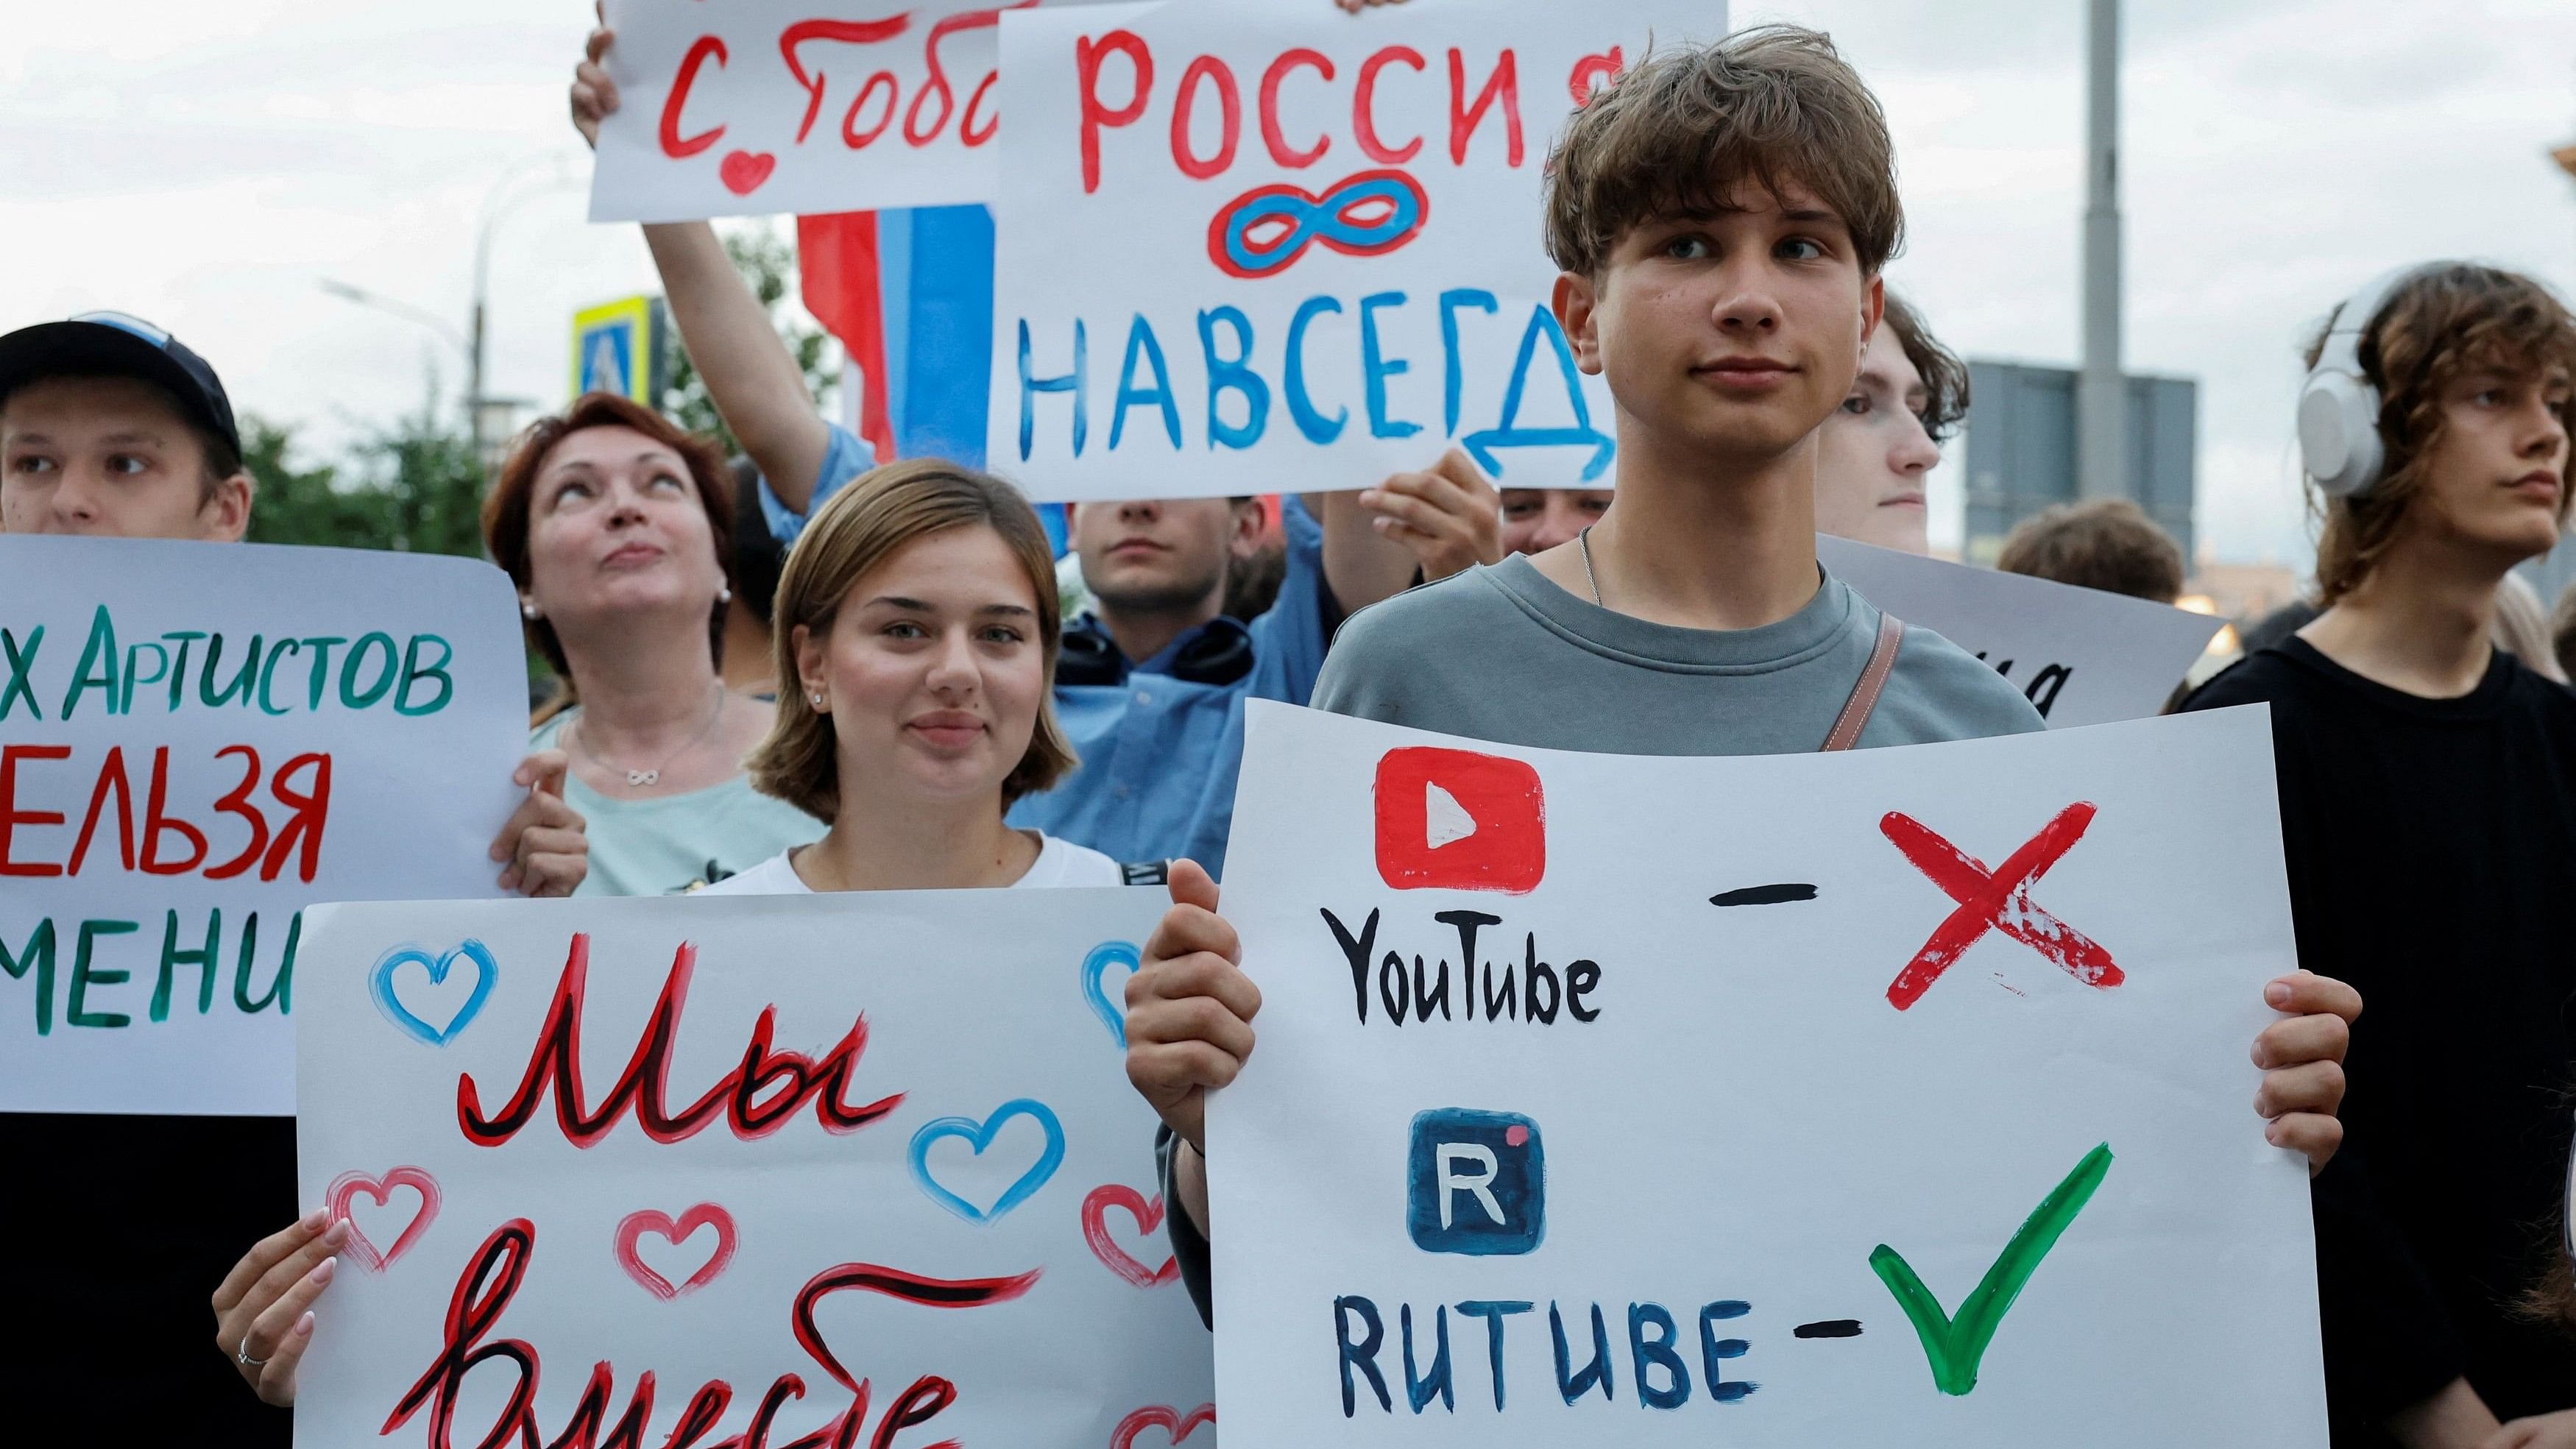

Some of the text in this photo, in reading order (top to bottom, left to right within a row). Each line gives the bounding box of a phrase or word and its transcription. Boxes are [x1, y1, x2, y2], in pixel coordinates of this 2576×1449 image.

[1320, 907, 1602, 1027] YouTube
[456, 932, 907, 1149] Мы
[1436, 1142, 1506, 1230] R
[1333, 1294, 1762, 1419] RUTUBE
